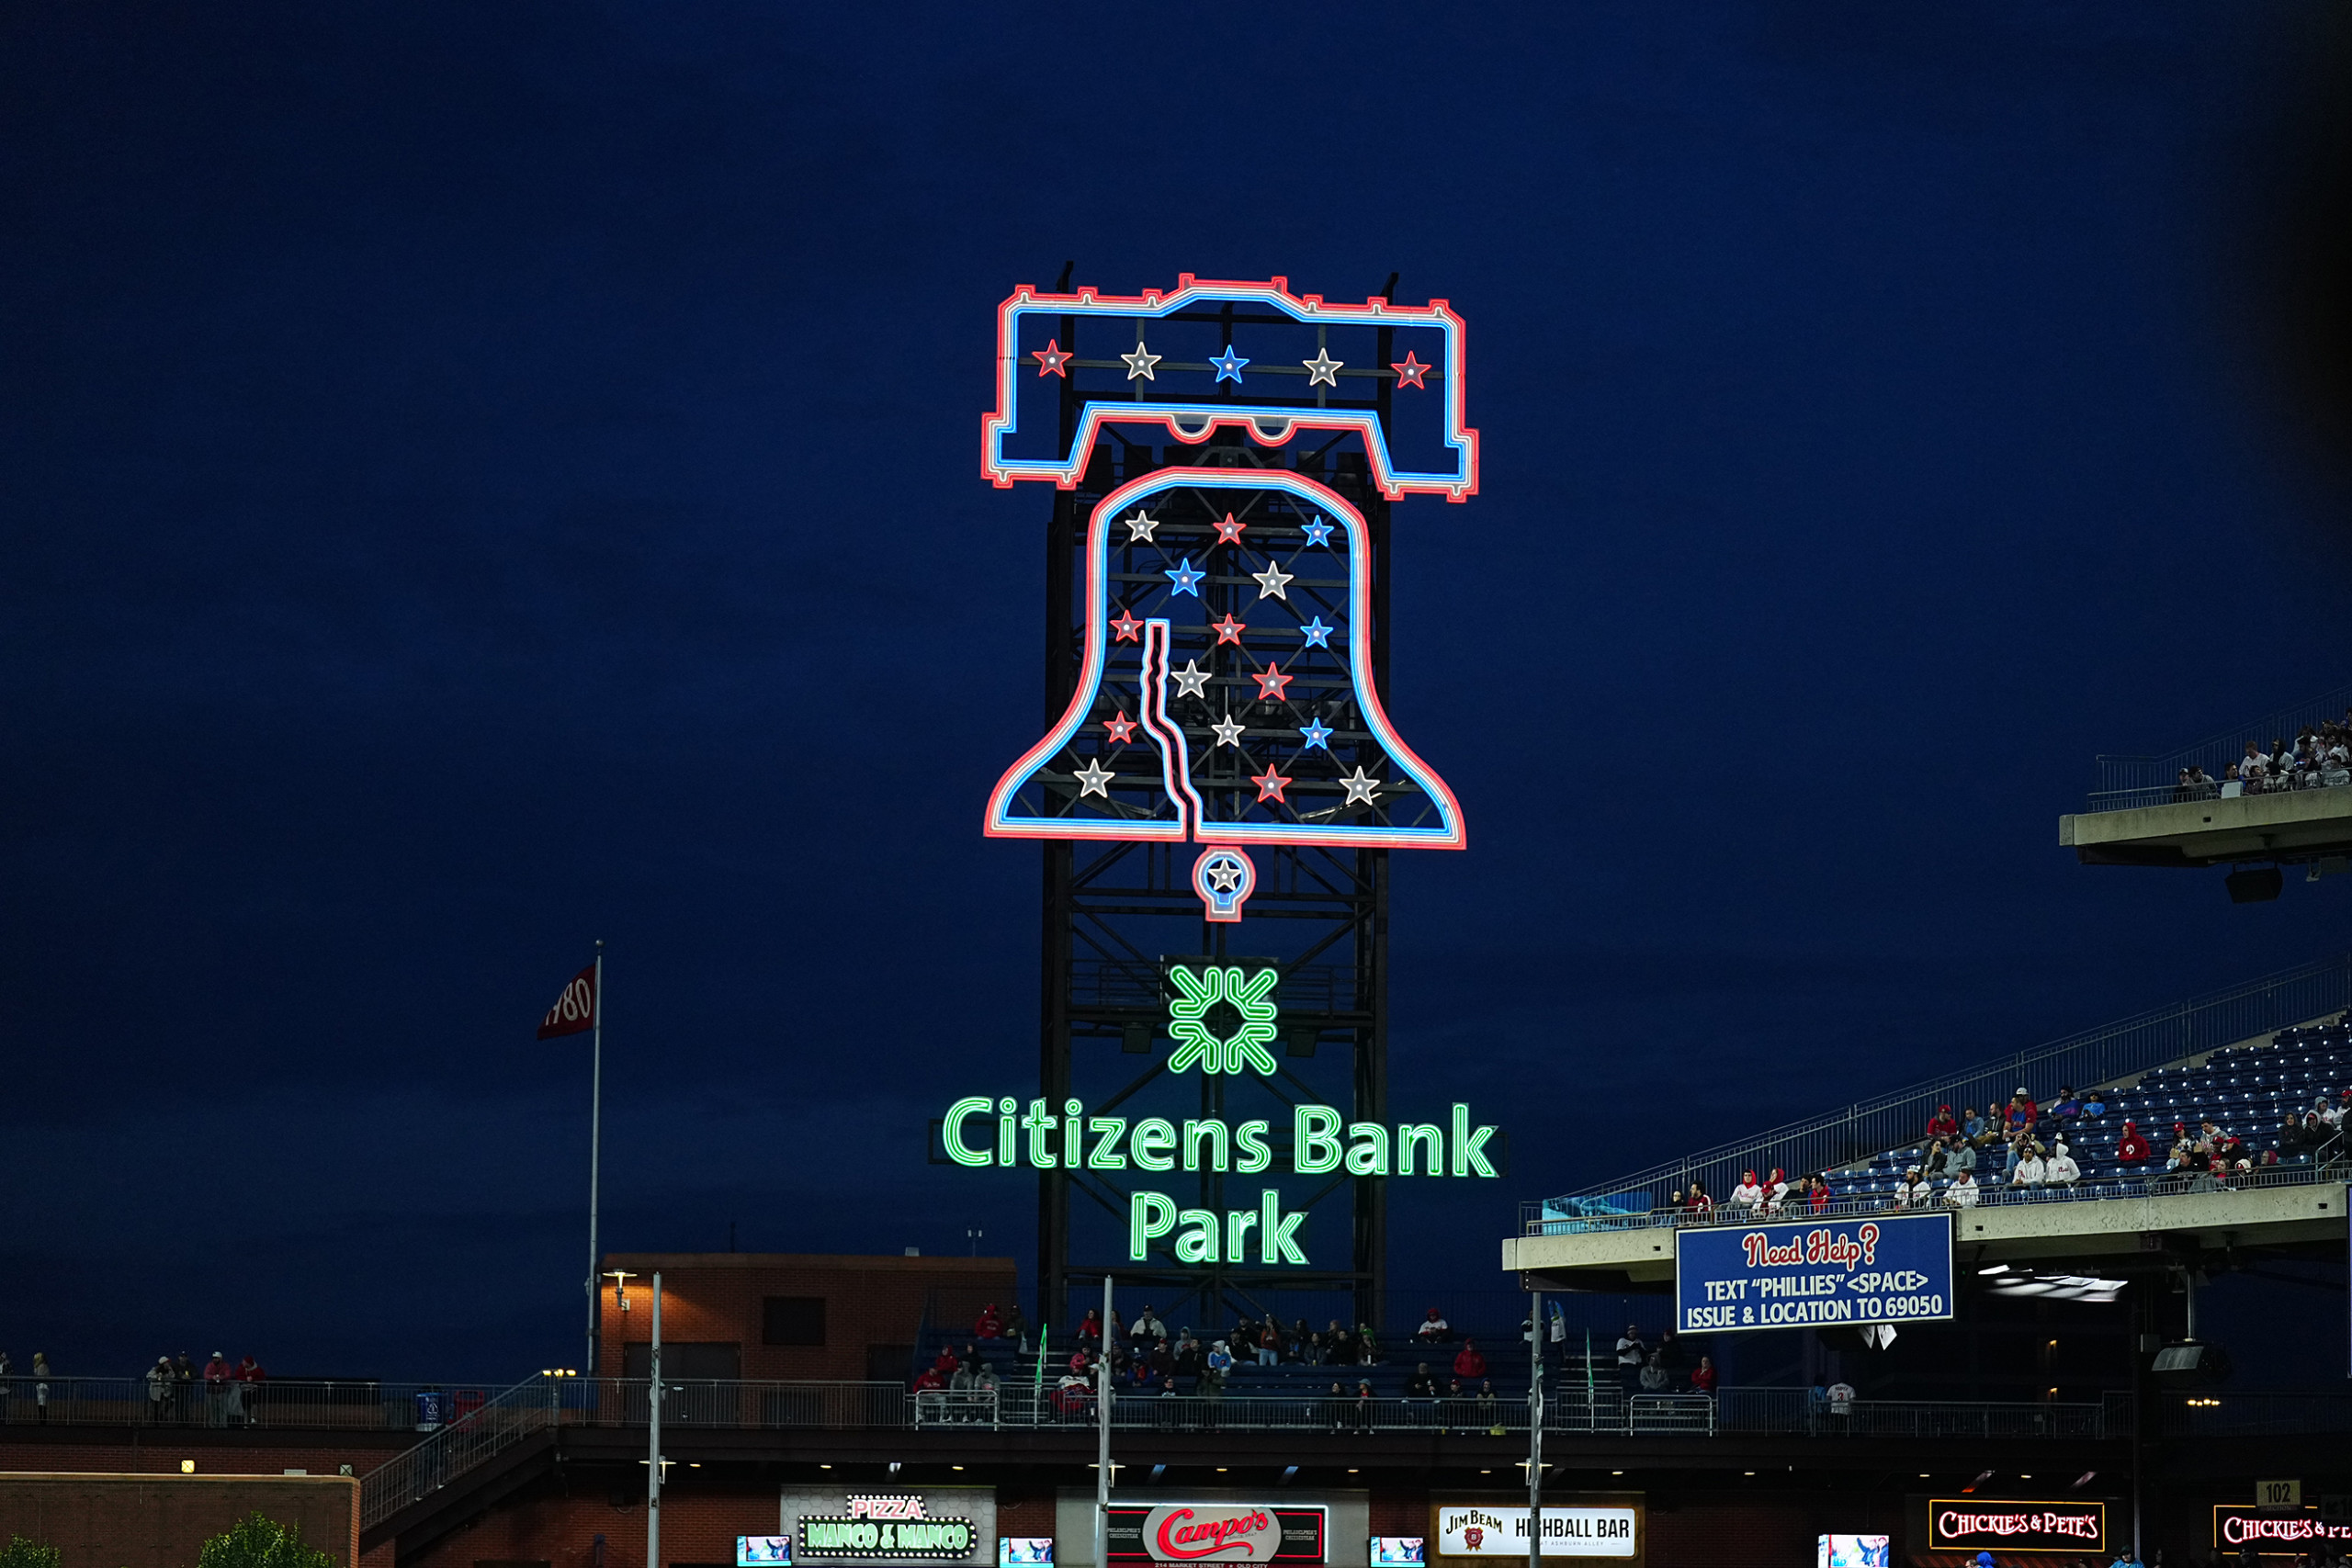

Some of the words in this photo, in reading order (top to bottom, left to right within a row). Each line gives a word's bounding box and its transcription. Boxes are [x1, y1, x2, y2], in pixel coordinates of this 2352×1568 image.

[942, 1096, 1271, 1174] Citizens
[1294, 1102, 1499, 1179] Bank
[1129, 1189, 1310, 1265] Park
[1742, 1232, 1804, 1268] Need
[1806, 1223, 1880, 1272] Help?
[1704, 1279, 1747, 1302] TEXT
[1847, 1270, 1928, 1293] <SPACE>
[1687, 1305, 1736, 1328] ISSUE
[1742, 1307, 1755, 1325] &
[1760, 1299, 1851, 1325] LOCATION
[1857, 1297, 1883, 1319] TO
[1885, 1294, 1942, 1317] 69050
[2266, 1483, 2291, 1504] 102
[852, 1499, 924, 1520] PIZZA
[1446, 1514, 1468, 1534] JIM
[1470, 1510, 1503, 1534] BEAM
[808, 1523, 878, 1549] MANCO
[879, 1524, 895, 1549] &
[897, 1524, 968, 1550] MANCO
[1158, 1508, 1268, 1560] Campo's
[1515, 1518, 1592, 1538] HIHBALL
[1597, 1518, 1629, 1538] BAR
[1939, 1511, 2029, 1539] CHICKIE'S
[2030, 1515, 2041, 1532] &
[2042, 1512, 2098, 1540] PETE'S
[2224, 1516, 2313, 1544] CHICKIE'S
[2314, 1521, 2325, 1537] &
